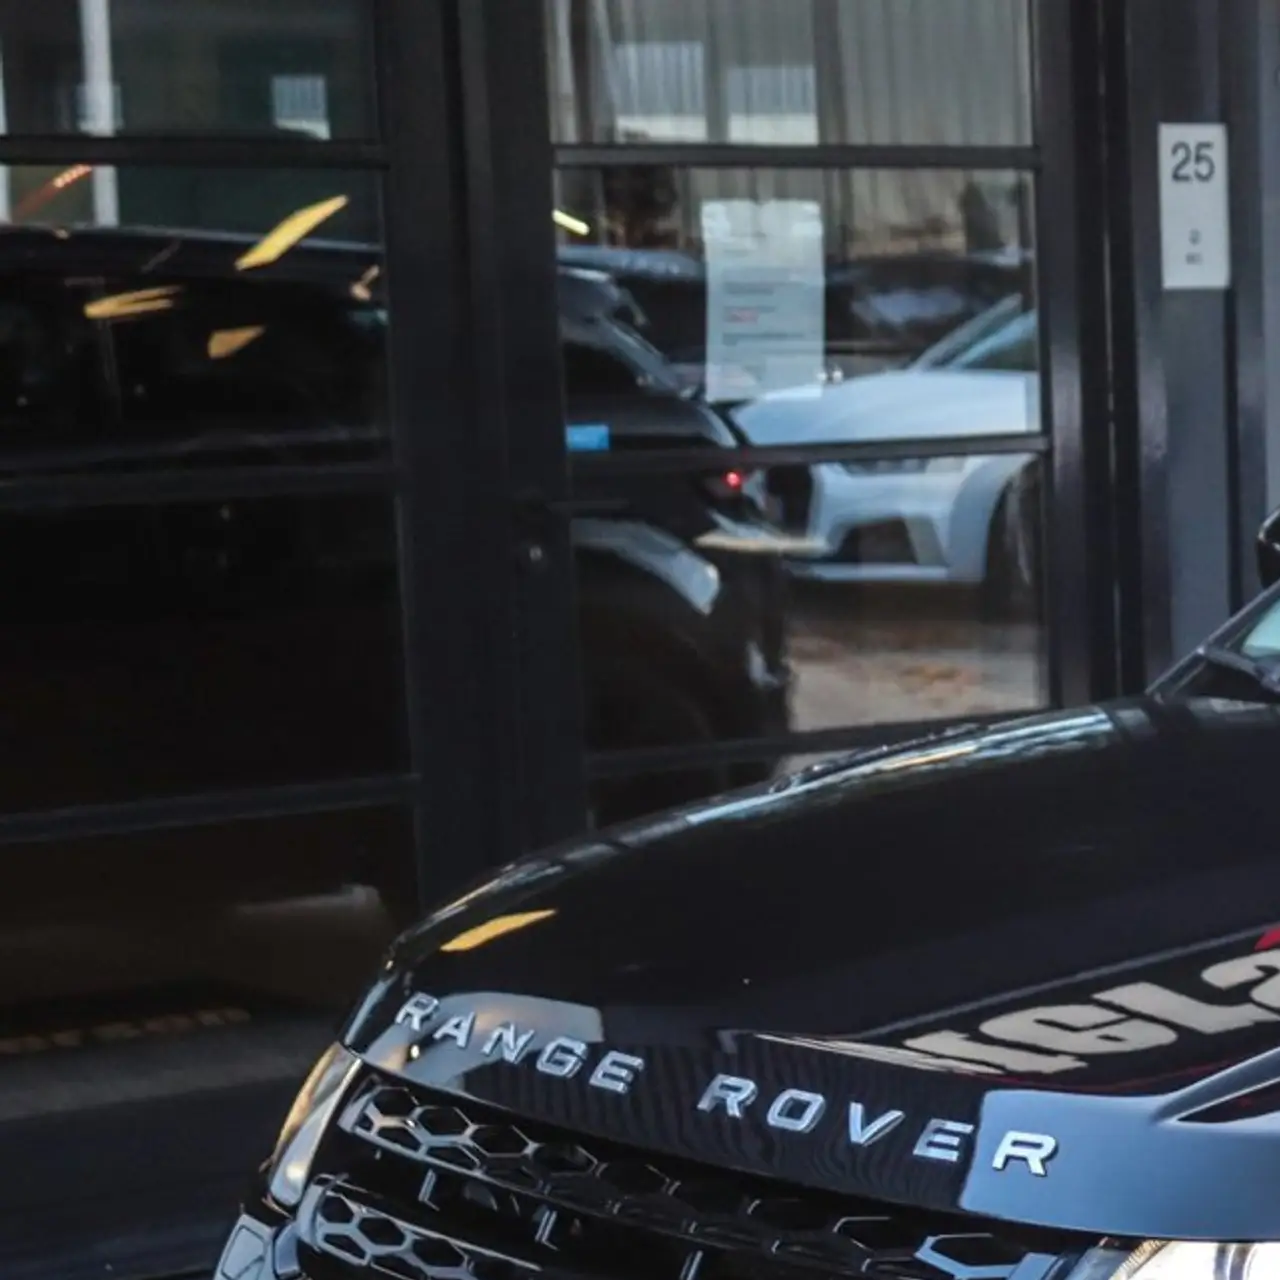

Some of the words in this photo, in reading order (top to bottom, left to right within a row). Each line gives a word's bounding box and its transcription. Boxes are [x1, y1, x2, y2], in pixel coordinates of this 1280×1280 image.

[1171, 140, 1216, 183] 25
[395, 991, 644, 1094] RANGE
[697, 1072, 1060, 1177] ROVER
